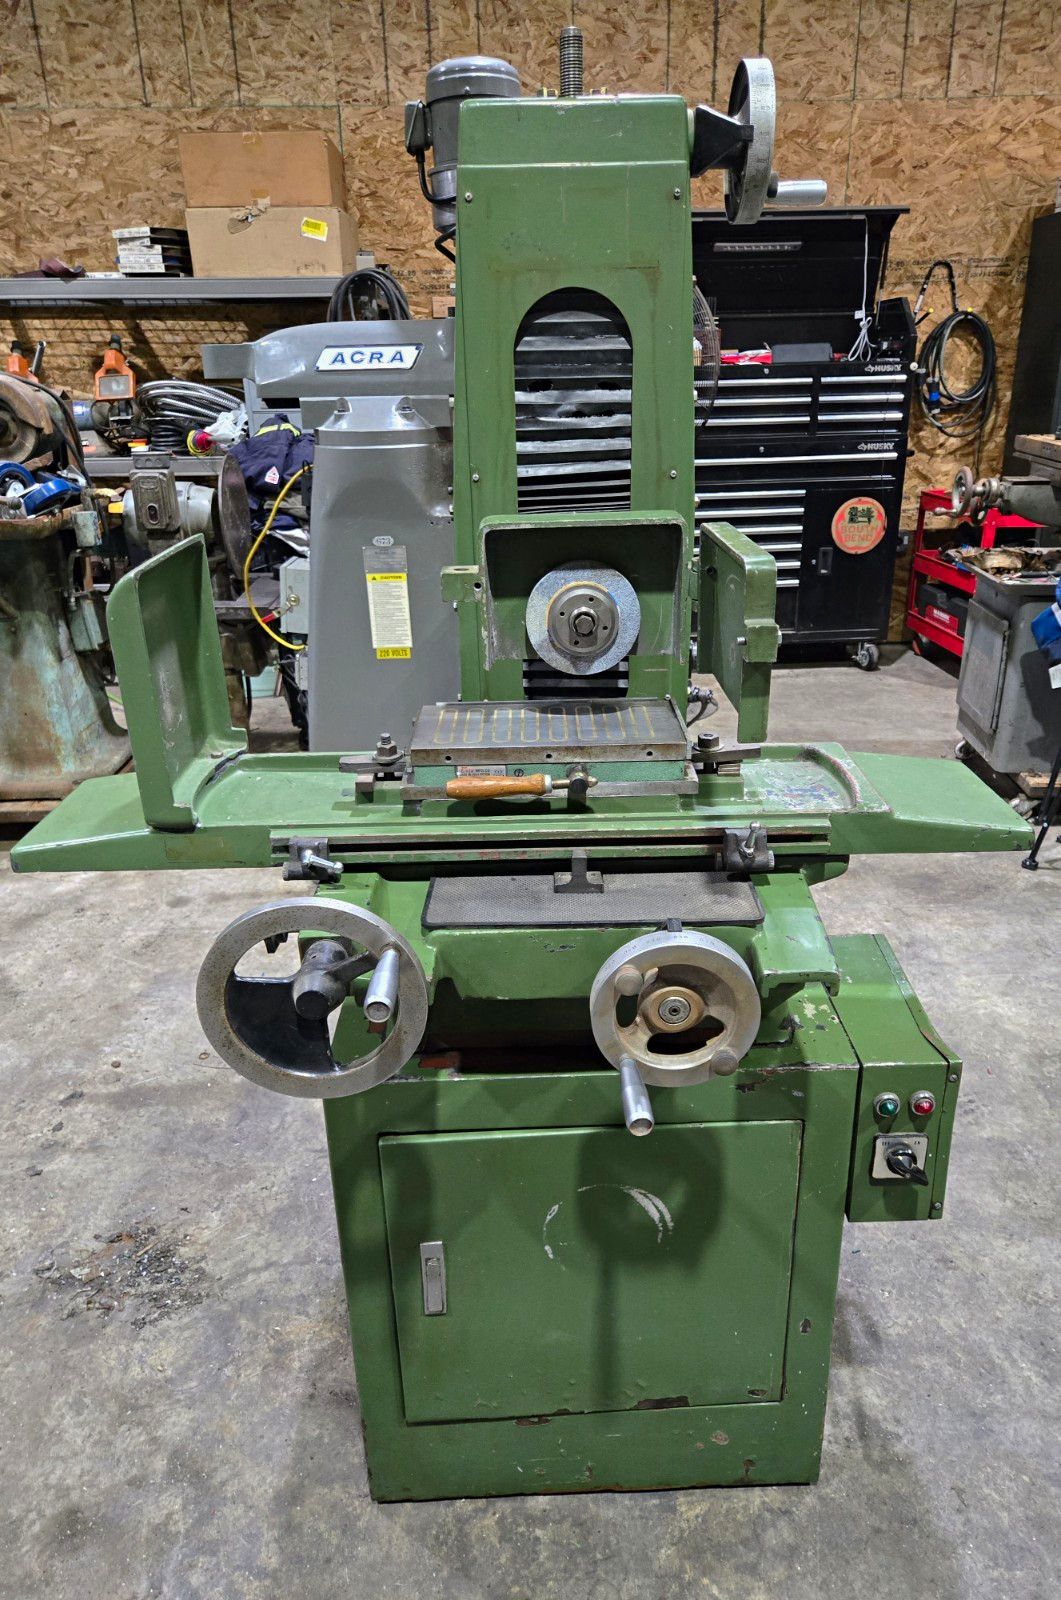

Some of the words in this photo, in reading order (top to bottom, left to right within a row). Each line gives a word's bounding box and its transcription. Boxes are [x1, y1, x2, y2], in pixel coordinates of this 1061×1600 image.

[328, 350, 406, 366] ACRA
[874, 364, 902, 373] HUSKY
[867, 442, 895, 451] HUSKY
[840, 524, 878, 534] SOUTH
[844, 534, 872, 543] BEND
[379, 649, 390, 658] 220
[391, 649, 408, 657] VOLTS
